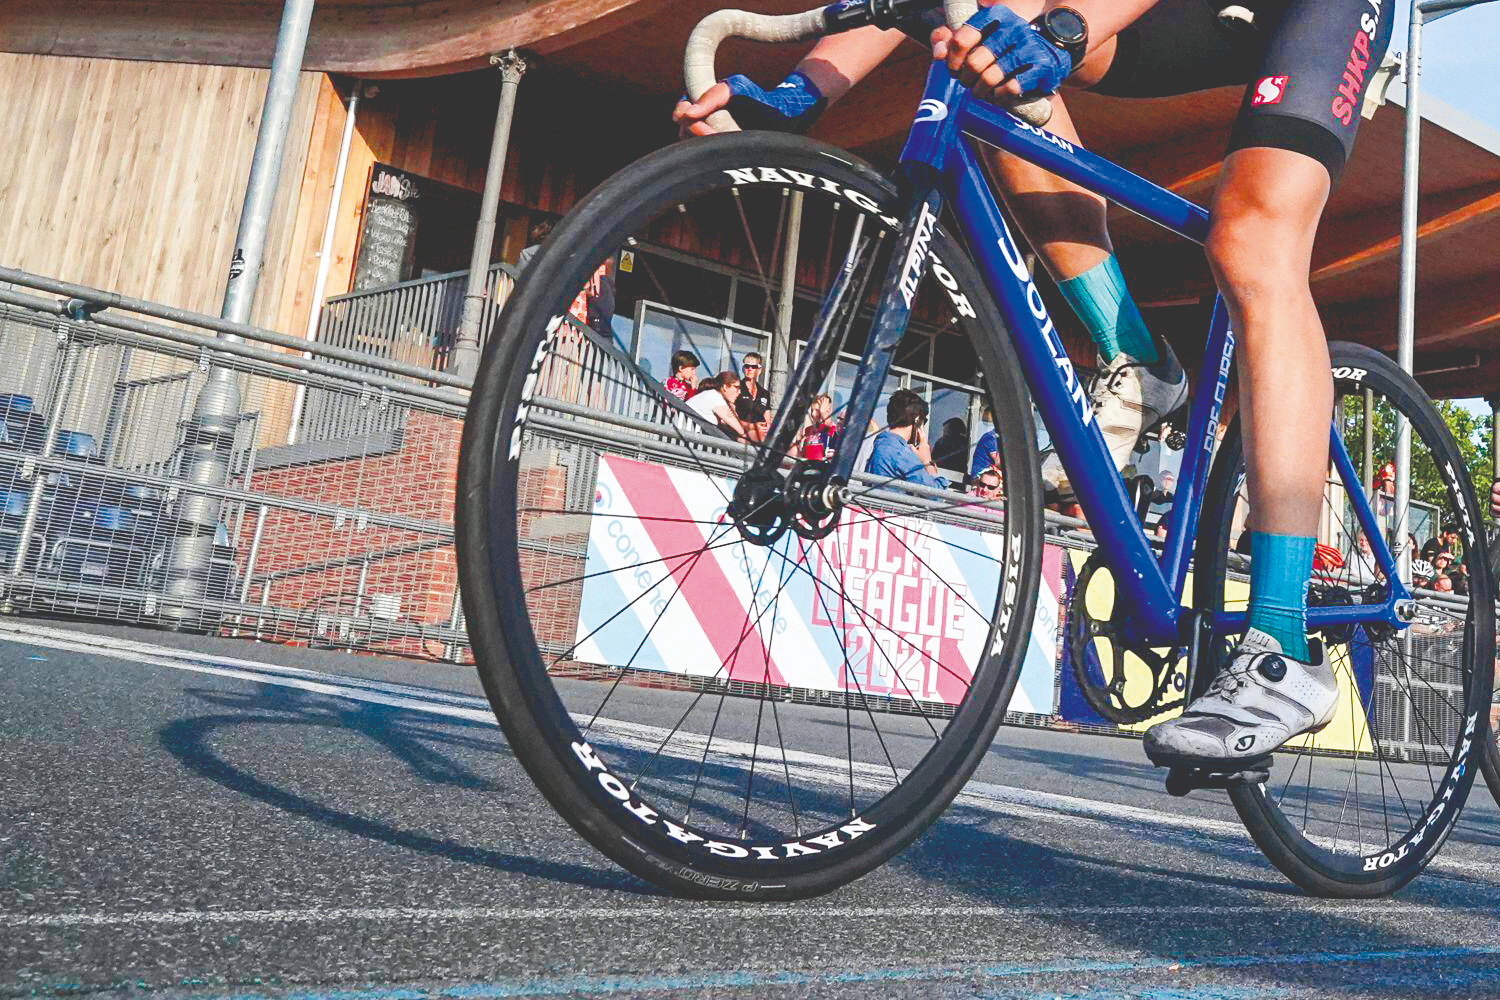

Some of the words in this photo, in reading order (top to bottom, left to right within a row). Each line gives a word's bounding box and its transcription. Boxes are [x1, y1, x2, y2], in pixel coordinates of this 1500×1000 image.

[899, 202, 937, 310] ALPINA
[607, 519, 668, 616] convene
[731, 541, 787, 635] convene
[812, 561, 967, 641] LEAGUE
[990, 532, 1022, 657] PISTA
[838, 627, 941, 698] 2021
[571, 740, 877, 860] NAVIGATOR
[1363, 711, 1479, 872] NAVIGATOR
